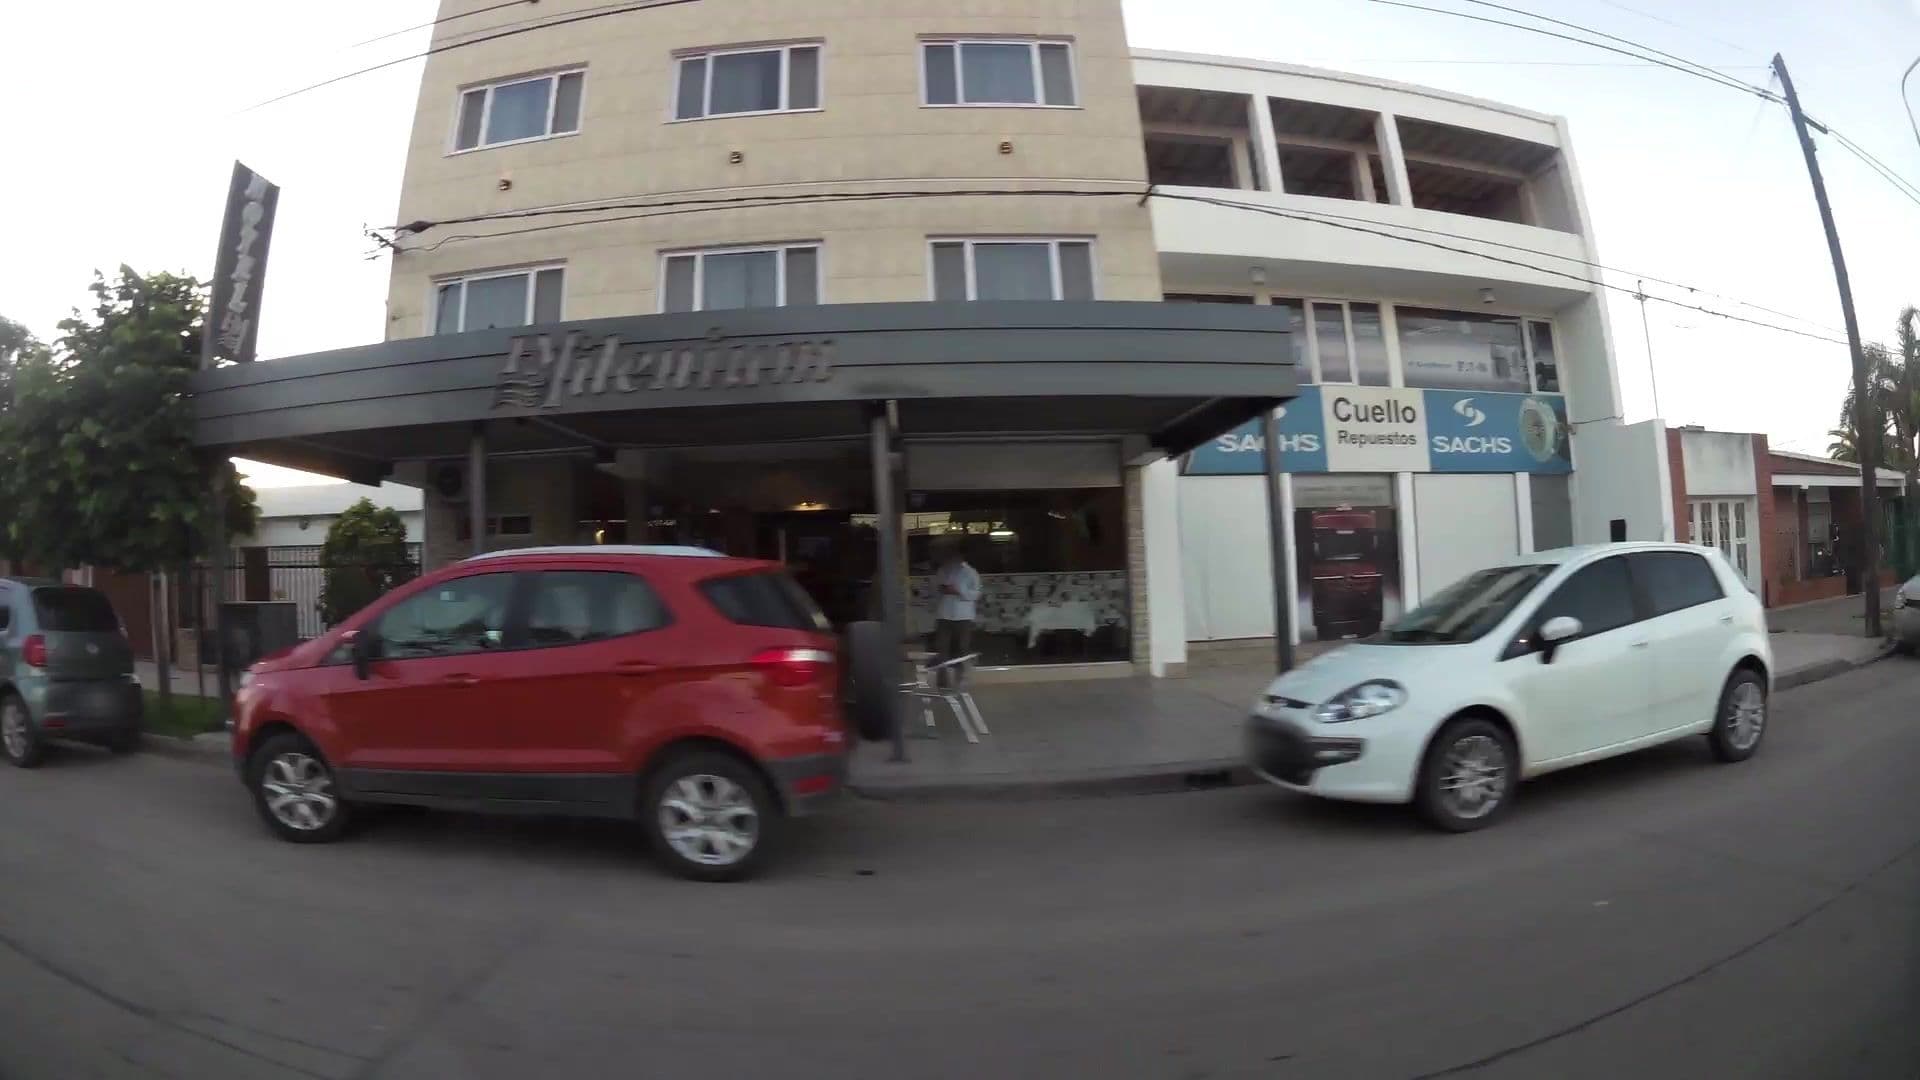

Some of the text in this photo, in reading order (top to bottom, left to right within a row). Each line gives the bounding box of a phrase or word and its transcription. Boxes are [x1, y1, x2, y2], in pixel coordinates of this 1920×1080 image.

[1333, 397, 1416, 424] Cuello
[1337, 430, 1417, 448] Repuestos
[1432, 436, 1512, 454] SACHS
